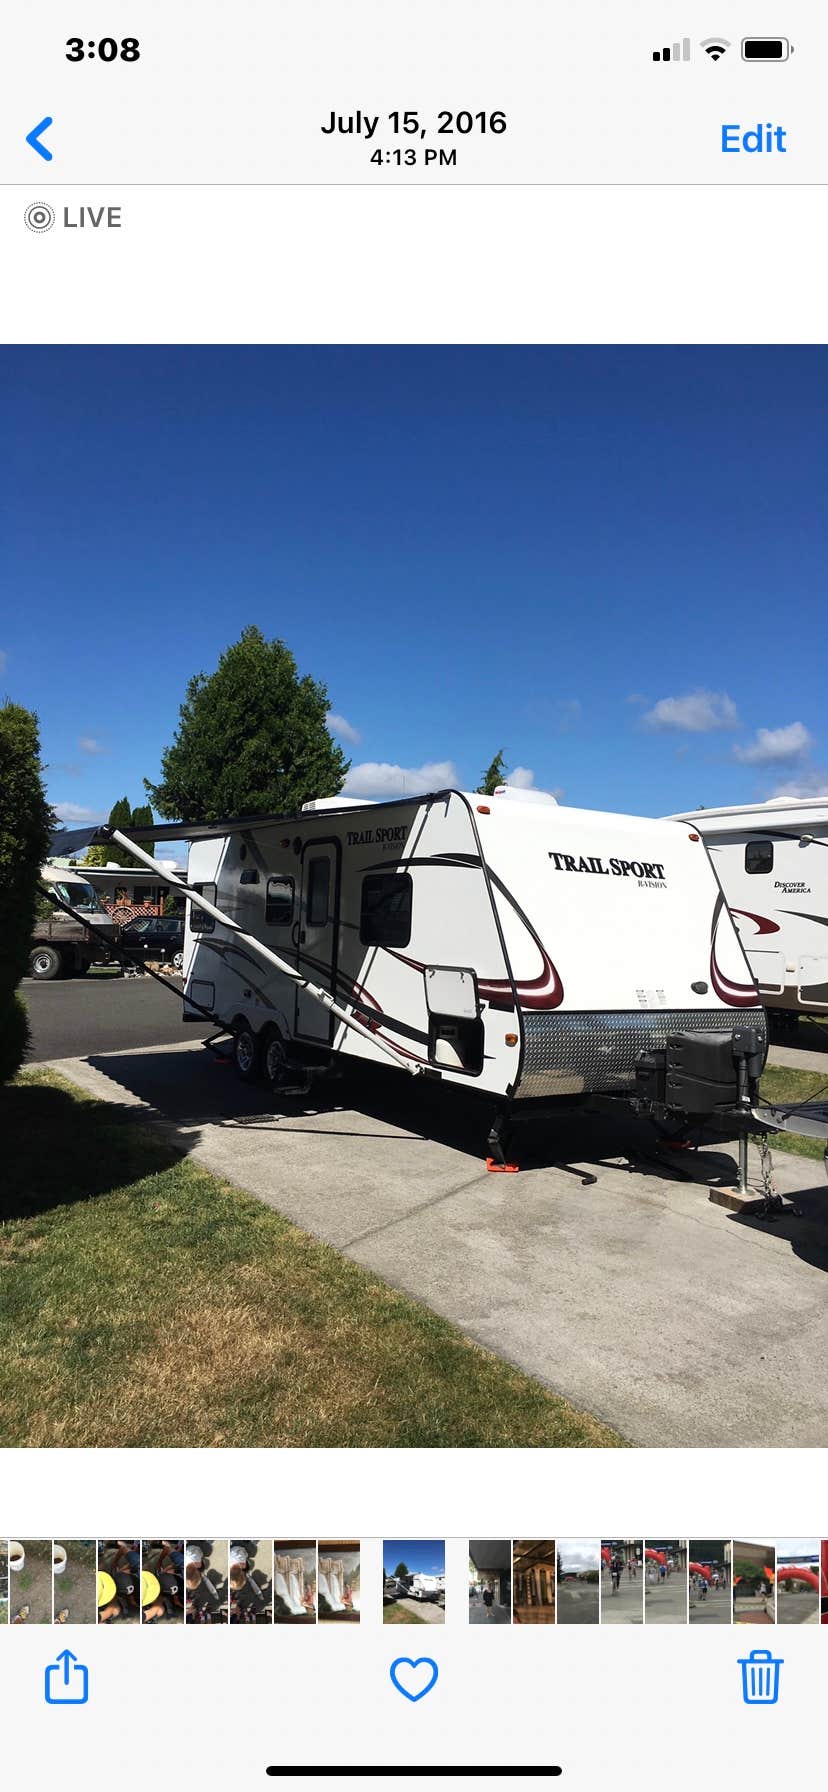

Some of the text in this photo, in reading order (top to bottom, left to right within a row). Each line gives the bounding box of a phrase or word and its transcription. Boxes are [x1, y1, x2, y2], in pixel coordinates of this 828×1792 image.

[346, 830, 374, 846] TRAIL
[375, 825, 408, 843] SPORT
[548, 851, 666, 880] TRAIL SPORT
